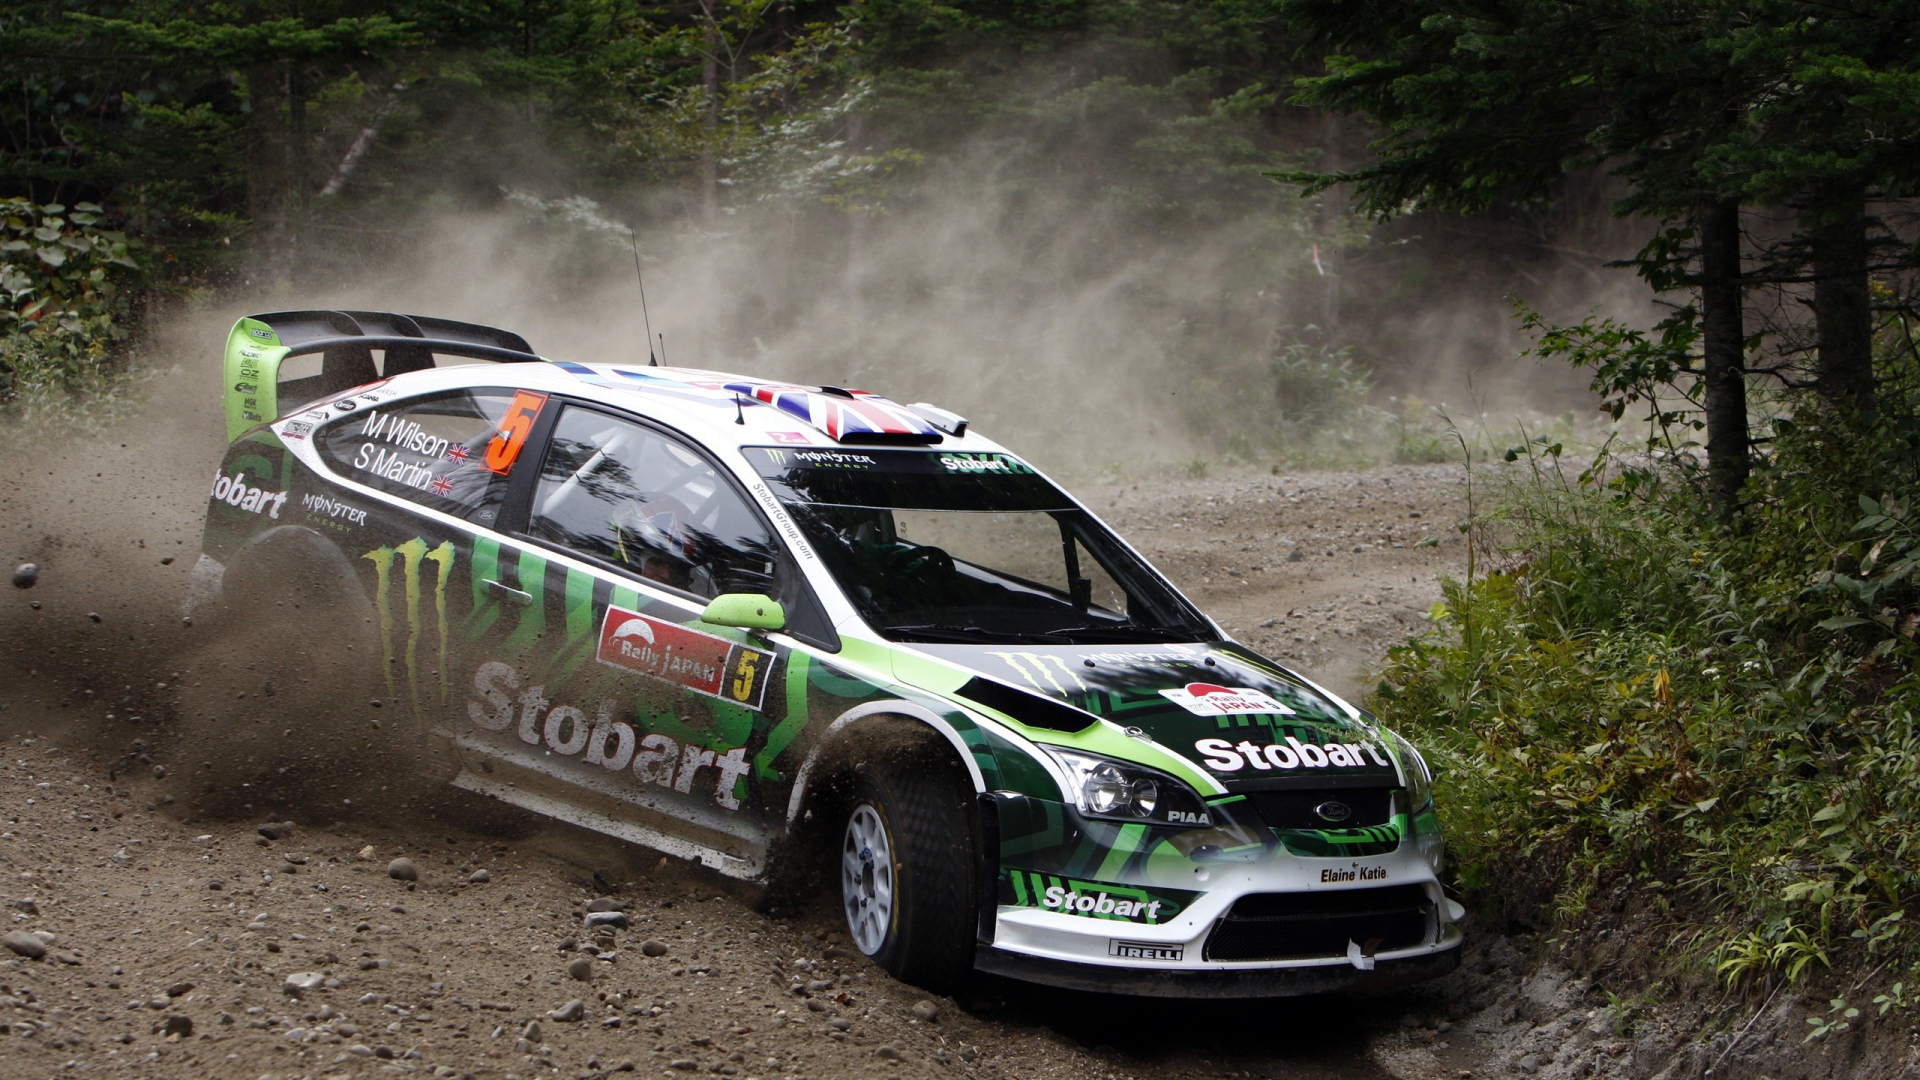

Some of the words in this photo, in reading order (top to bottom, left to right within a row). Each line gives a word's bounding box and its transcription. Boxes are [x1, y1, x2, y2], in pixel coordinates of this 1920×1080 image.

[361, 410, 389, 439] M
[386, 416, 449, 459] Wilson
[486, 392, 542, 471] 5
[354, 442, 375, 469] S
[370, 448, 433, 490] Martin
[814, 462, 869, 470] ENERGY
[940, 457, 1009, 471] Stobart
[306, 512, 352, 533] ENERGY
[753, 483, 813, 560] StobartGroup.com
[621, 640, 660, 667] Rally
[733, 650, 760, 702] 5
[1210, 695, 1247, 704] Rally
[1212, 702, 1266, 714] JAPAN
[467, 661, 751, 812] Stobart
[1195, 736, 1389, 772] Stobart
[1167, 810, 1210, 825] PIAA
[1321, 868, 1356, 883] Elaine
[1360, 866, 1387, 881] Katie
[1043, 886, 1162, 919] Stobart
[1109, 939, 1183, 961] PIRELLI
